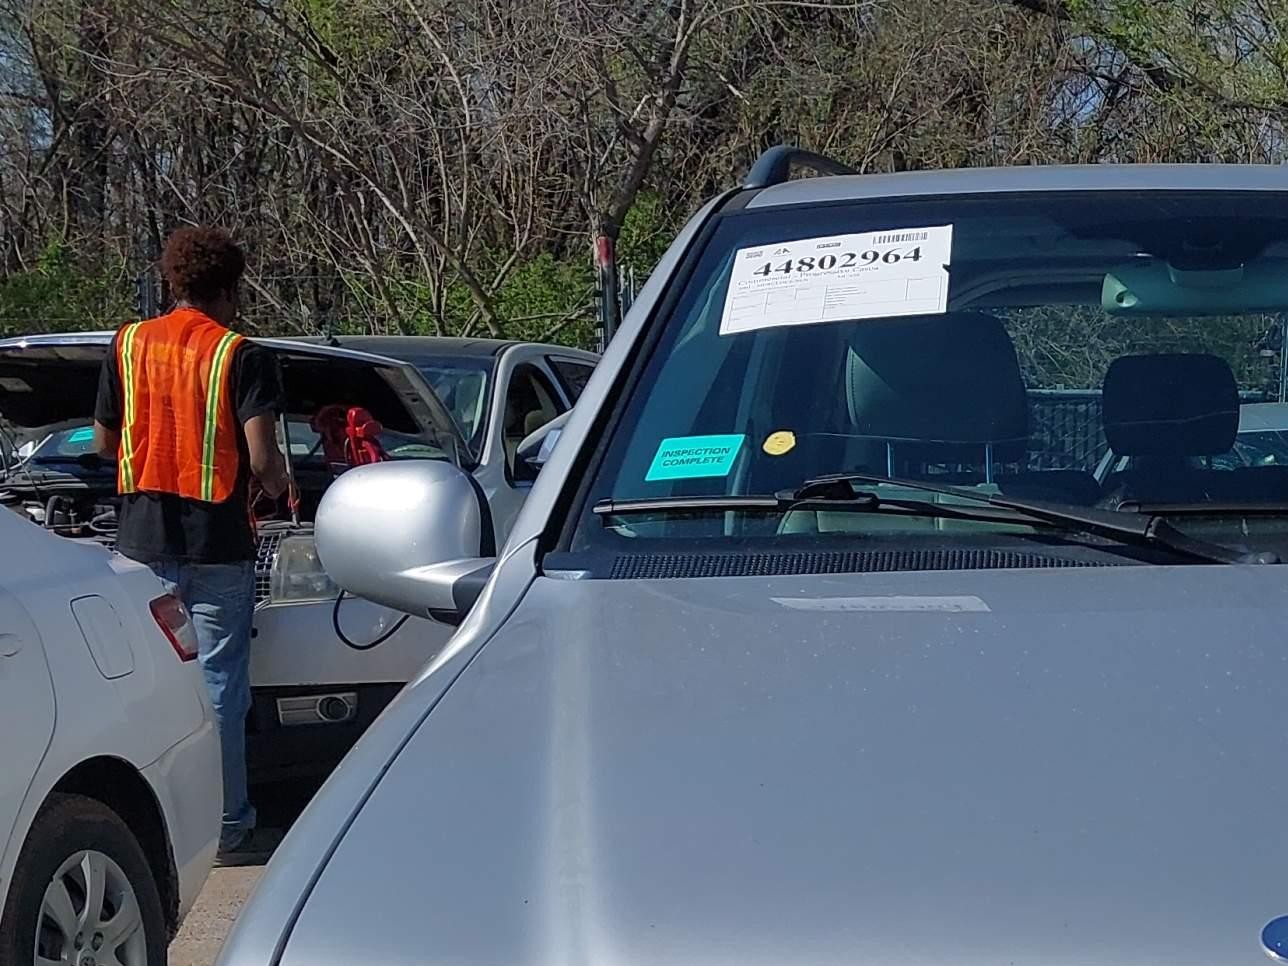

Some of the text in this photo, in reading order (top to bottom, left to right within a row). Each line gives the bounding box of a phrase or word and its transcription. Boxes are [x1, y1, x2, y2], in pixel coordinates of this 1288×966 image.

[753, 246, 922, 276] 44802964
[662, 447, 730, 457] INSPECTION
[662, 456, 724, 467] COMPLETE
